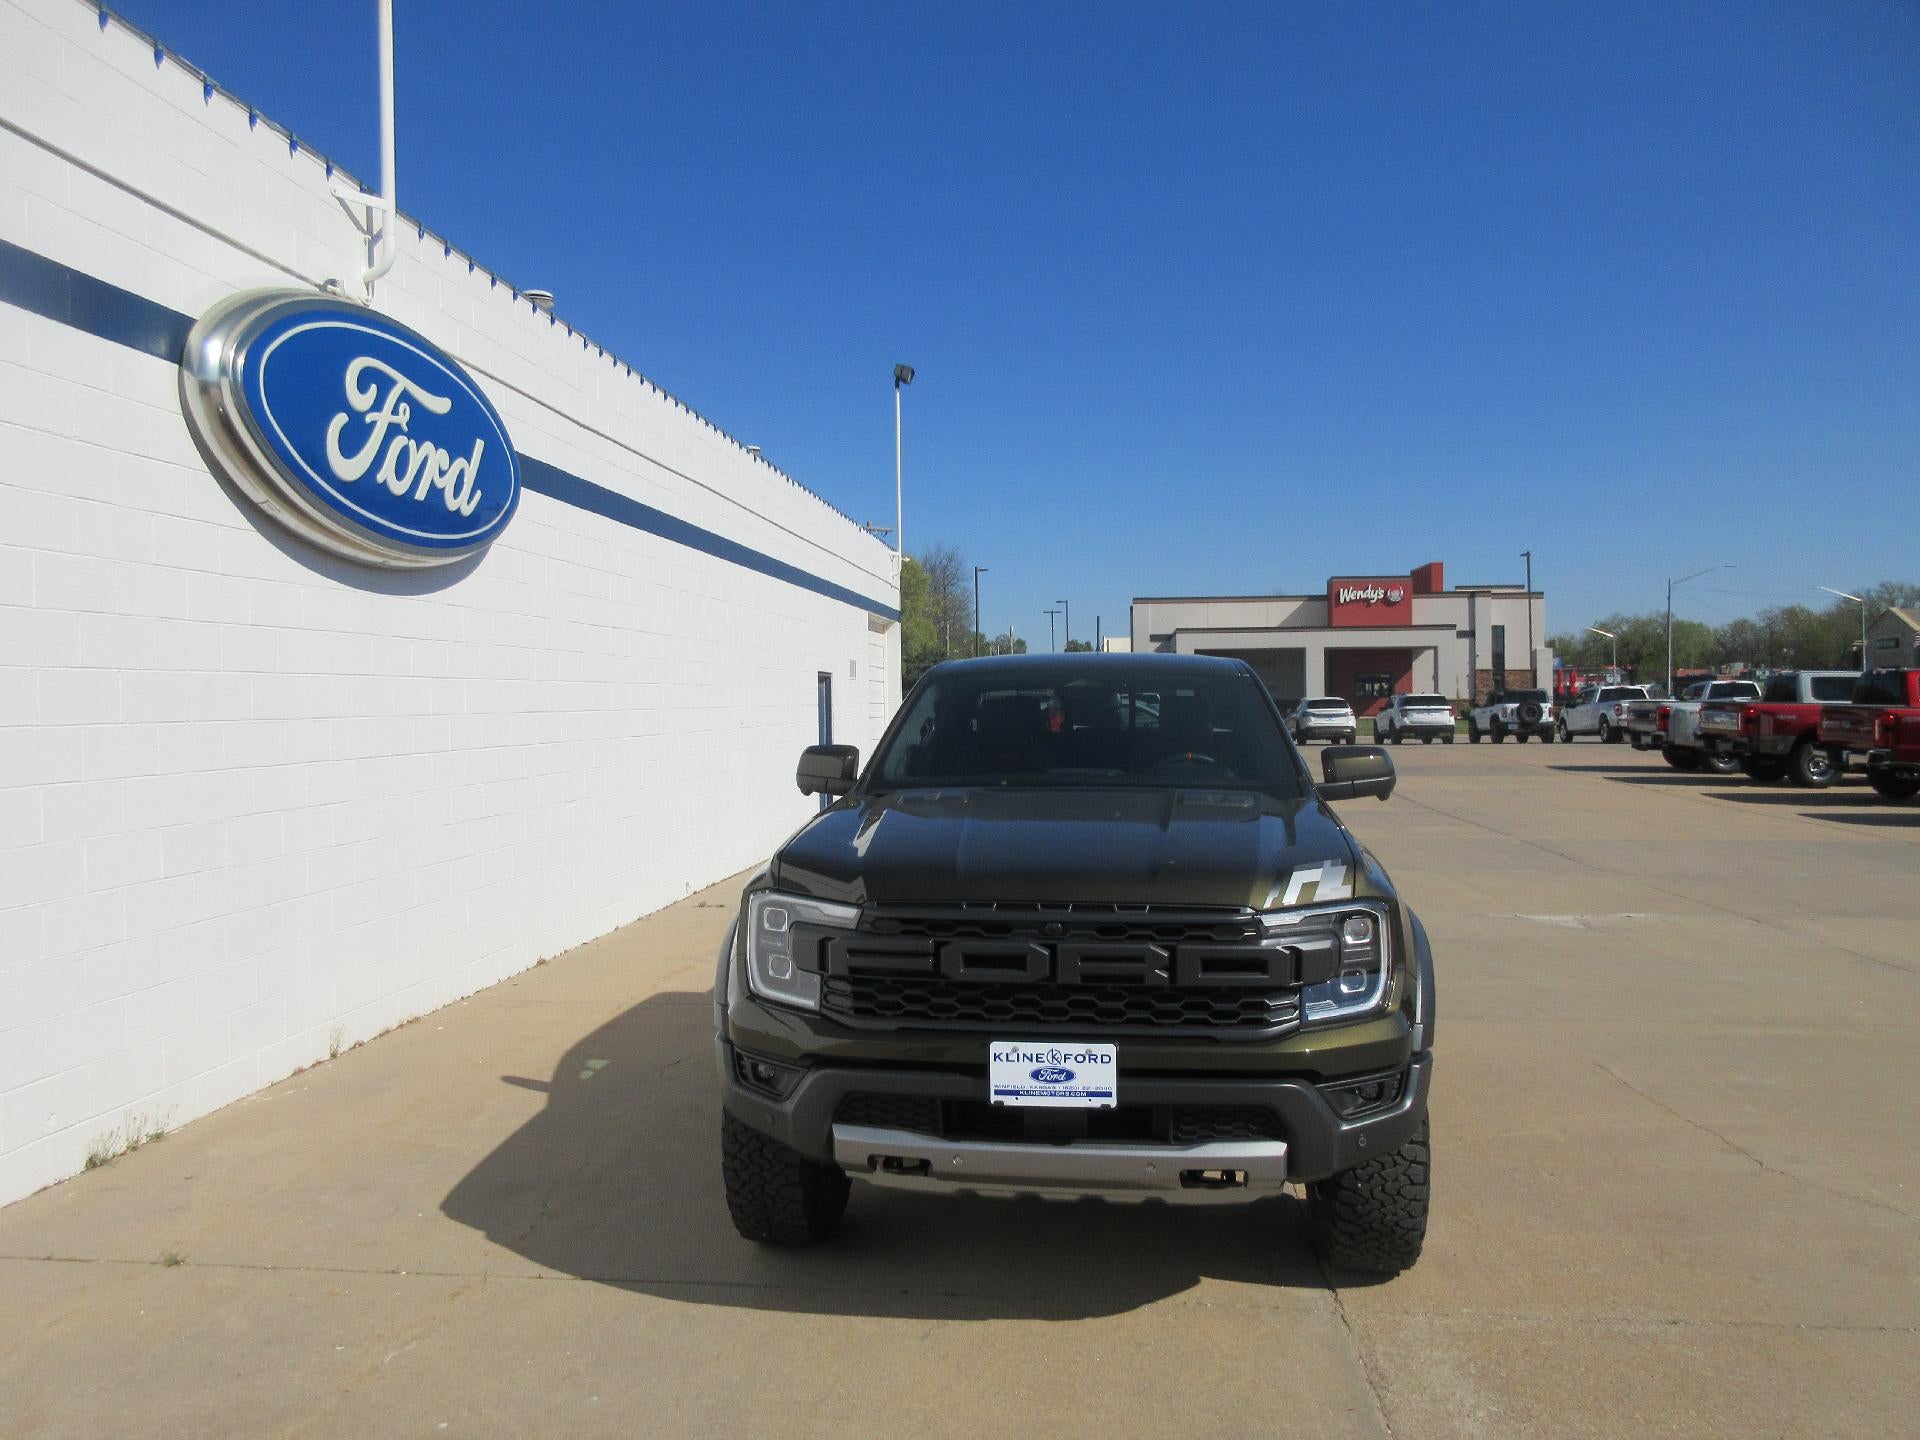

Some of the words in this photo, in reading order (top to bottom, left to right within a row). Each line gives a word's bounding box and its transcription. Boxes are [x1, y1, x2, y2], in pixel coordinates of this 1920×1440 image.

[326, 356, 485, 517] Ford
[1339, 584, 1385, 604] Wendy's
[829, 937, 1293, 987] FORD
[994, 1053, 1045, 1064] KLINE
[1064, 1054, 1112, 1064] FORD
[1038, 1069, 1066, 1081] Ford
